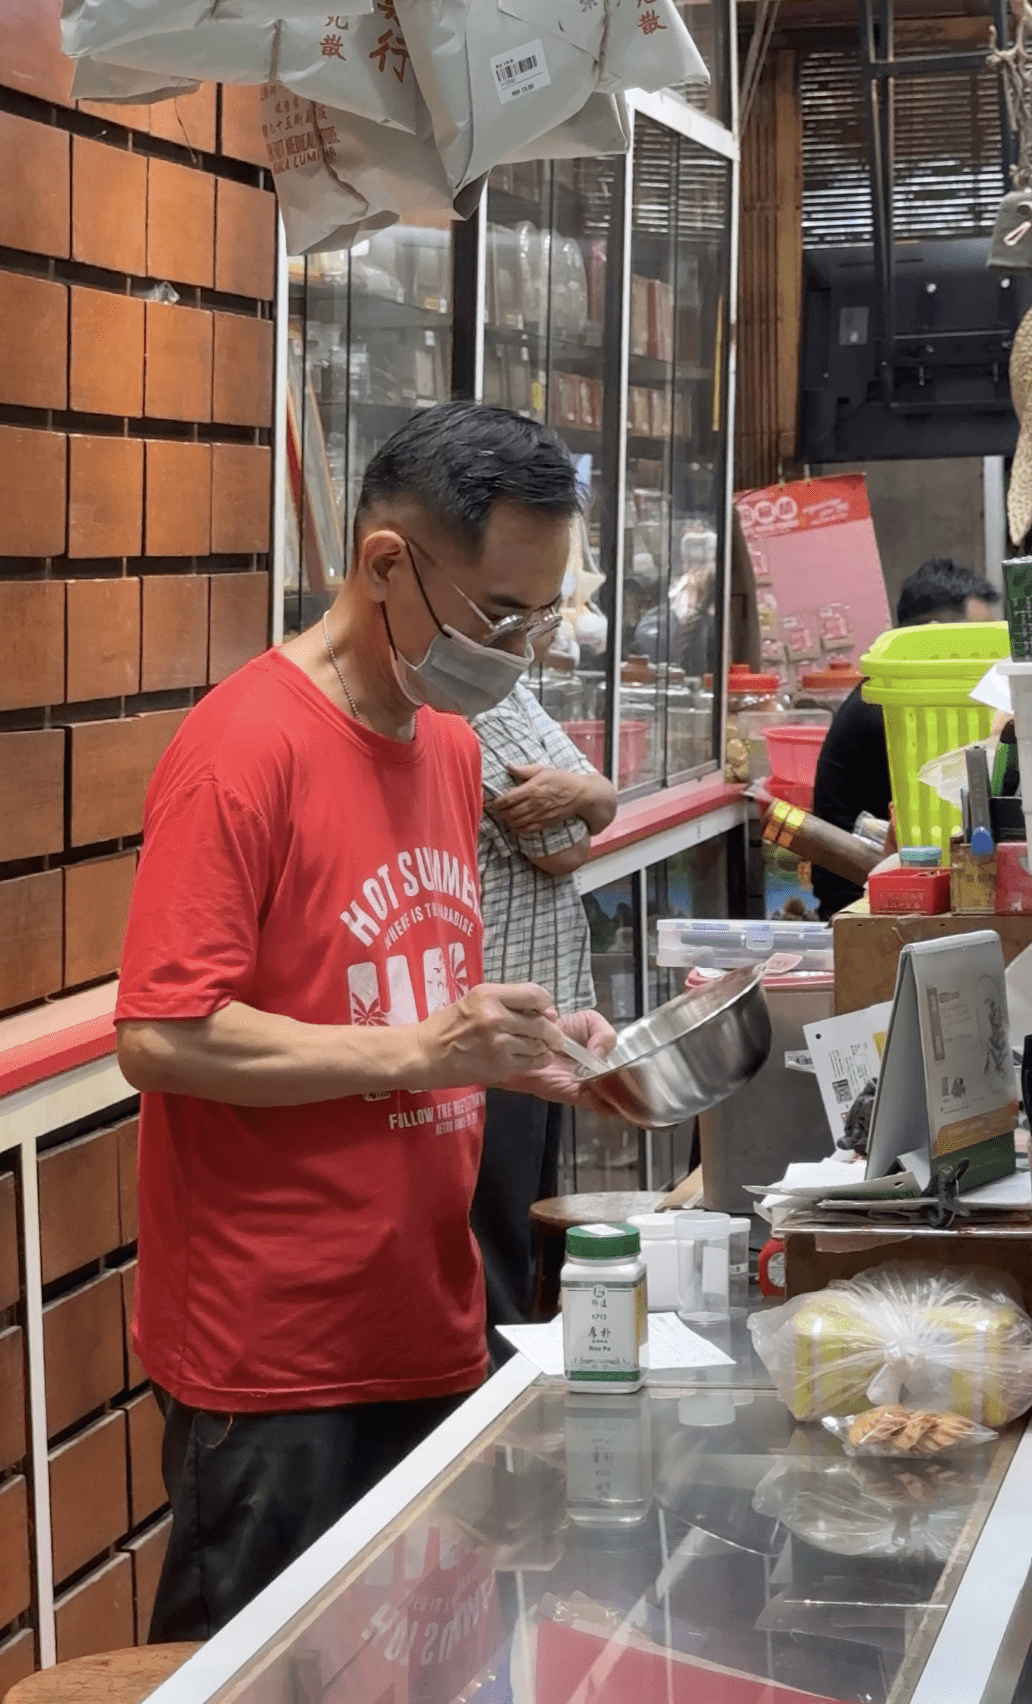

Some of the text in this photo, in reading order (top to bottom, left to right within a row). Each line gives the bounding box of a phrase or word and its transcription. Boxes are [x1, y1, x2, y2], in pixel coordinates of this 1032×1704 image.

[339, 864, 399, 947] HOT
[410, 906, 424, 923] IS
[388, 1107, 434, 1130] FOLLOW
